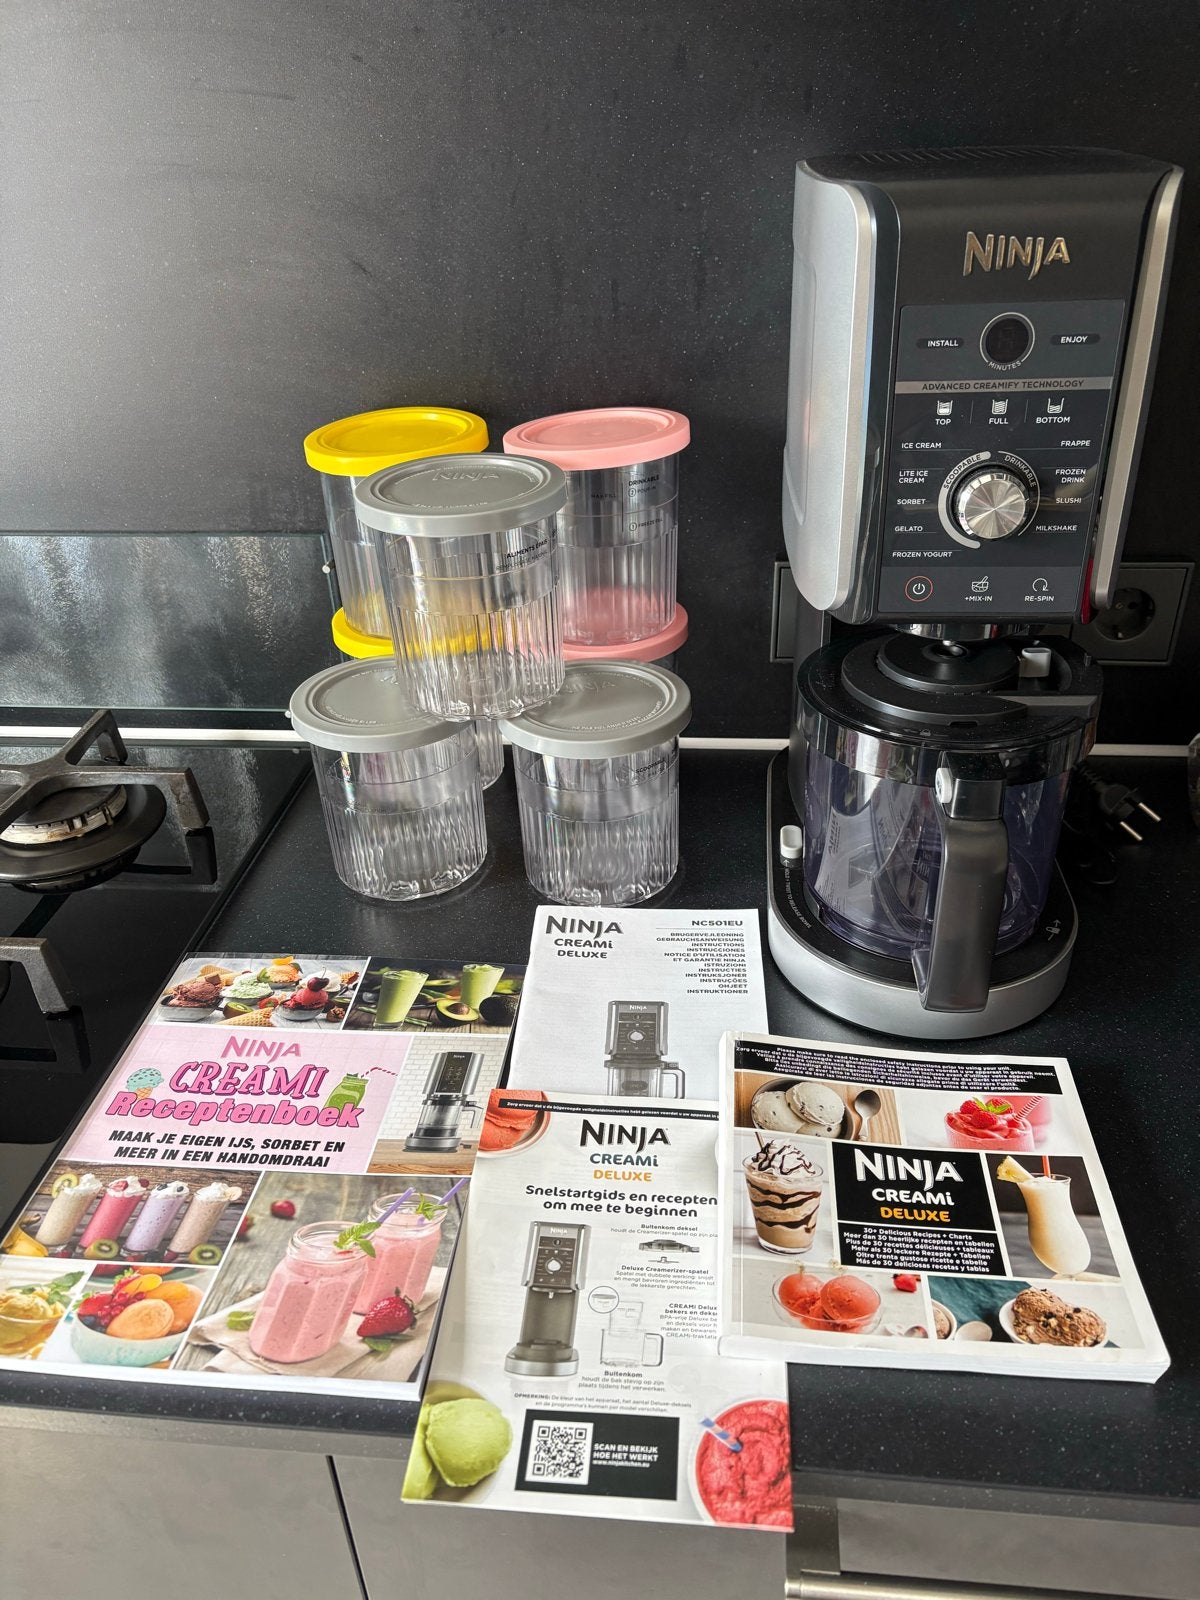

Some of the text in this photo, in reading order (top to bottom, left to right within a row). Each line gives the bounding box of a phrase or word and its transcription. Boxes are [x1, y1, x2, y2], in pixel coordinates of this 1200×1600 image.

[963, 231, 1070, 280] NINJA
[1060, 335, 1088, 344] ENJOY
[988, 361, 1021, 371] MINUTES
[922, 380, 1084, 391] ADVANCED CREAMIFY TECHNOLOGY
[433, 472, 499, 481] NINJA
[943, 454, 982, 490] SCOOPABLE
[1004, 454, 1037, 488] DRINKABLE
[628, 474, 660, 486] DRINKABLE
[507, 545, 536, 559] ALIMENTS
[546, 915, 623, 939] NINJA
[554, 938, 613, 949] CREAMi
[558, 950, 607, 959] DELUXE
[220, 1035, 301, 1064] NINJA
[169, 1061, 329, 1100] CREAMI
[105, 1091, 364, 1128] Receptenboek
[109, 1130, 345, 1152] MAAK JE EIGEN IJS, SORBET EN
[580, 1119, 671, 1154] NINJA
[114, 1146, 330, 1167] MEER IN EEN HANDOMDRAAI
[590, 1153, 659, 1167] CREAMi
[593, 1169, 652, 1182] DELUXE
[854, 1148, 963, 1191] NINJA
[526, 1185, 718, 1206] Snelstartgids en recepten
[872, 1188, 955, 1206] CREAMi
[543, 1201, 698, 1218] om mee te beginnen
[880, 1206, 951, 1222] DELUXE
[641, 1223, 675, 1231] Buitenkom
[888, 1235, 919, 1244] heerlijke
[921, 1238, 953, 1247] recepten
[965, 1240, 995, 1248] tabellen
[913, 1231, 941, 1239] Recipes
[914, 1243, 954, 1251] délicieuses
[893, 1248, 920, 1256] leckere
[921, 1250, 952, 1259] Rezepte
[960, 1252, 990, 1260] Tabellen
[646, 1266, 709, 1275] Creamerizer-spatel
[894, 1261, 934, 1269] deliciosas
[604, 1370, 643, 1378] Buitenkom
[593, 1443, 616, 1451] SCAN
[629, 1446, 658, 1454] BEKIJK
[629, 1453, 658, 1462] WERKT
